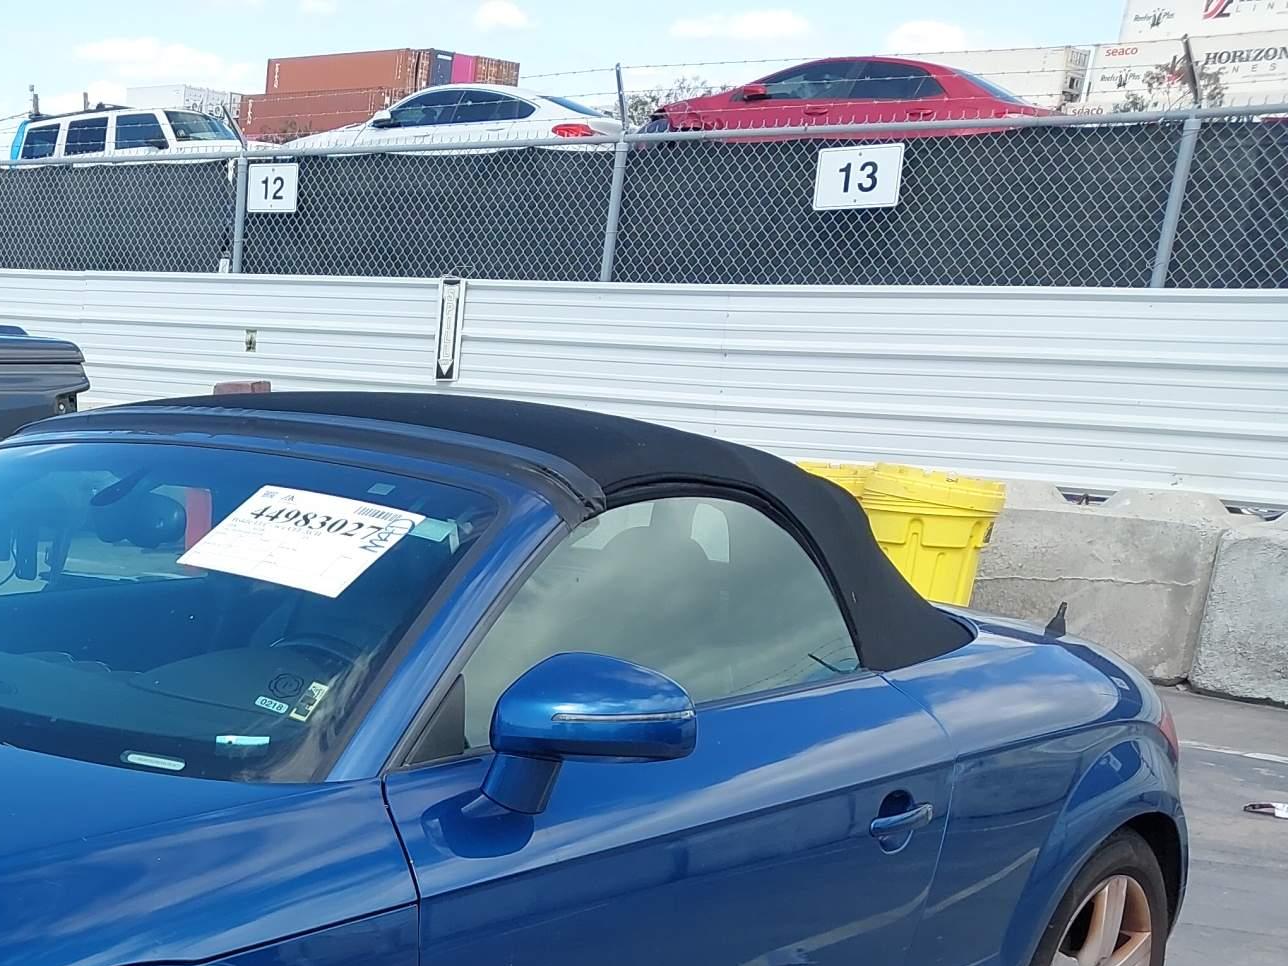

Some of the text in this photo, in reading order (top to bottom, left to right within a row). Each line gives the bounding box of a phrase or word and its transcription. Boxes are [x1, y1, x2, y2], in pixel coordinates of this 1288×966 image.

[1105, 47, 1138, 57] seaco
[261, 176, 284, 200] 12
[839, 161, 878, 193] 13
[250, 505, 384, 540] 44983027
[260, 698, 284, 711] 0218
